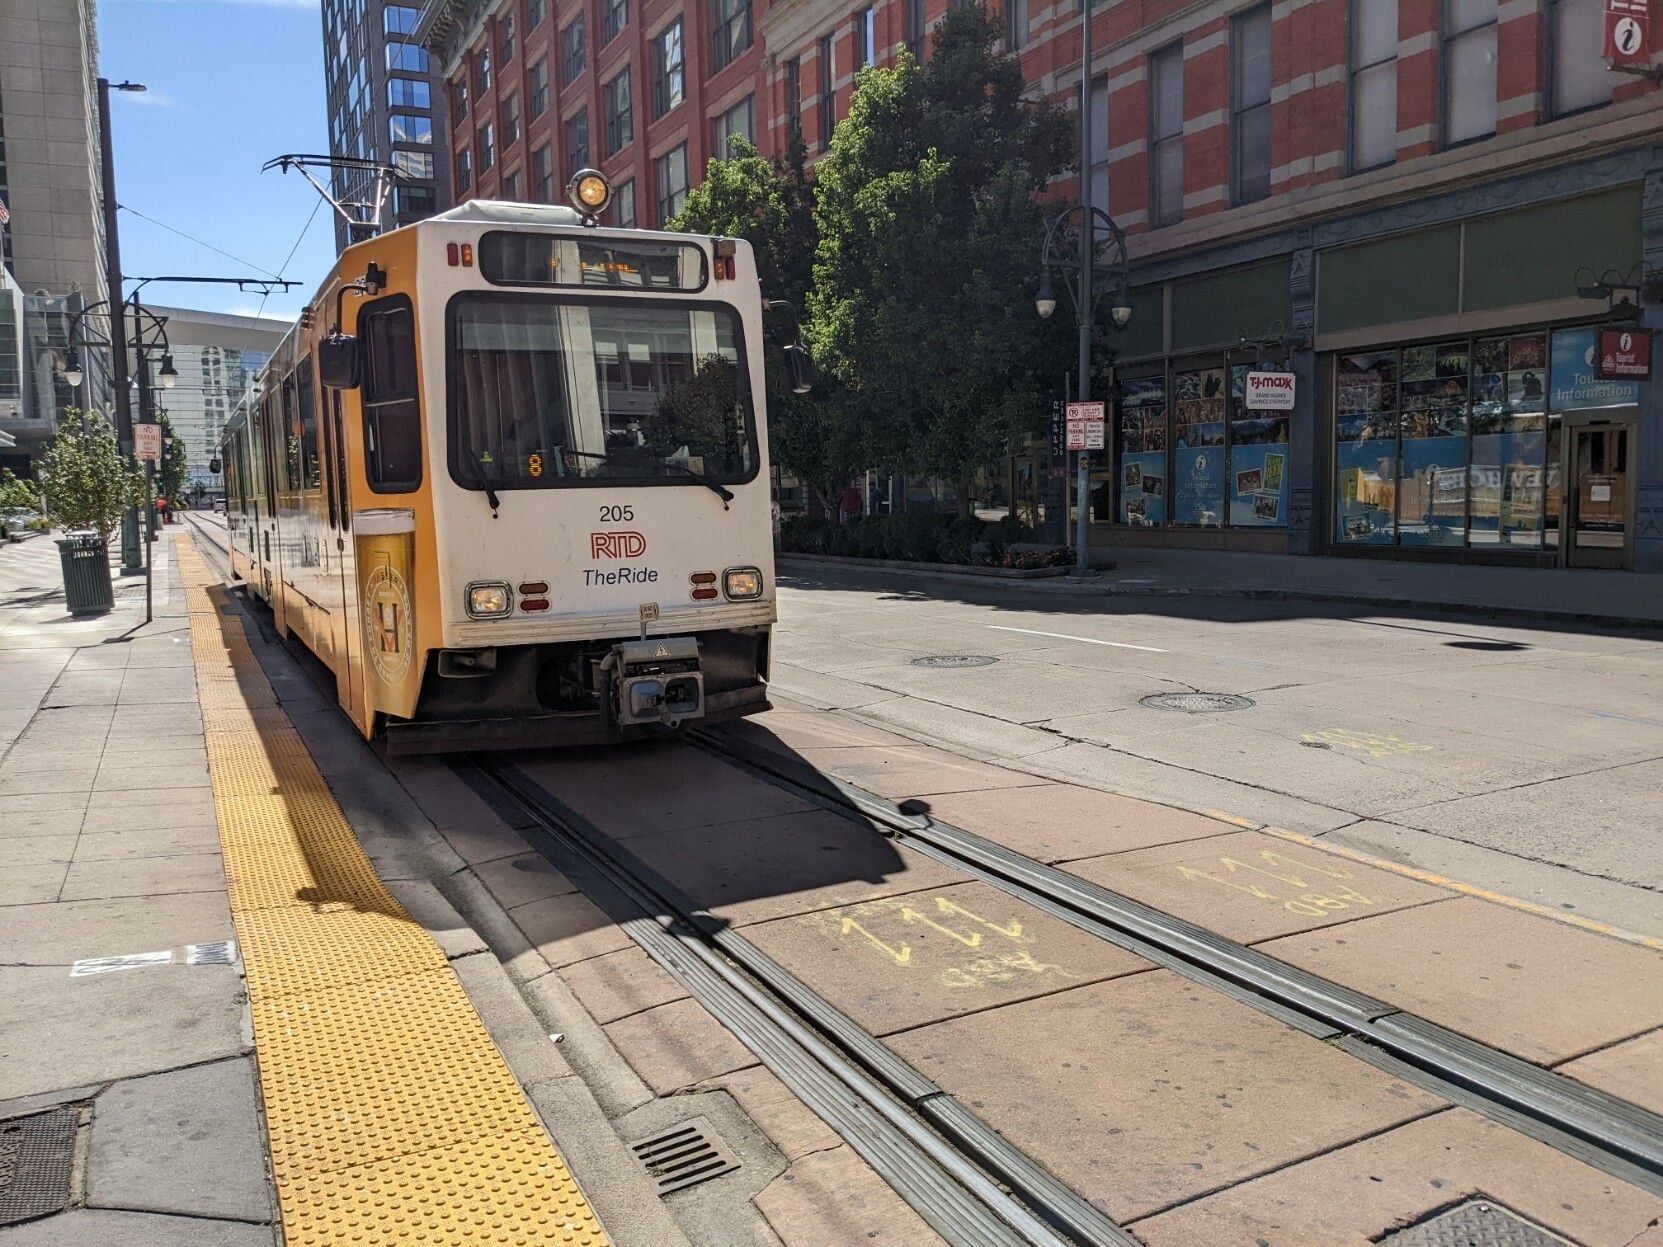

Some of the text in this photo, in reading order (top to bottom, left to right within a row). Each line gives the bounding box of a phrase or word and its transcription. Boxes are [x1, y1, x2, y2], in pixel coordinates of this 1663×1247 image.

[1557, 385, 1632, 400] Information
[599, 505, 634, 522] 205
[590, 531, 647, 559] RTD
